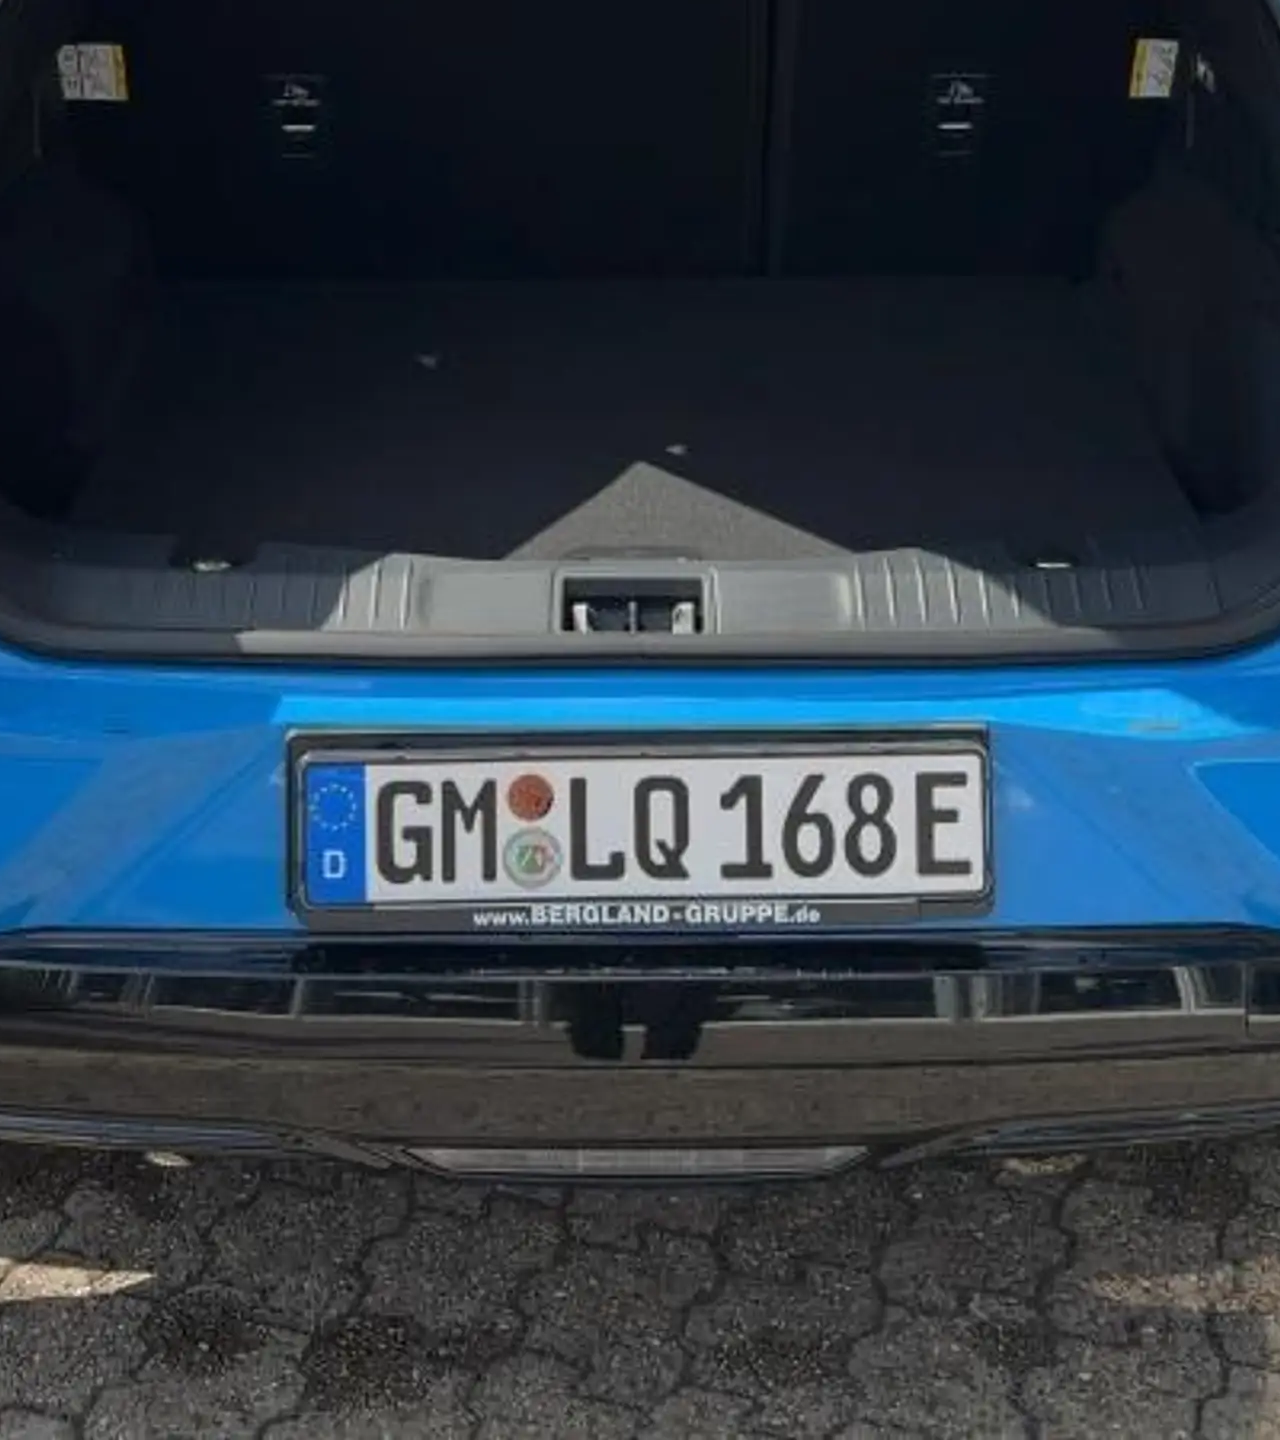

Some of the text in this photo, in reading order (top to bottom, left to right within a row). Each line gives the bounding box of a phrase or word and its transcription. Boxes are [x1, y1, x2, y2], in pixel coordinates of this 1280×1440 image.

[376, 771, 972, 884] GM LQ 168E
[323, 849, 347, 879] D
[473, 902, 821, 927] www.BERGLAND-GRUPPE.de
